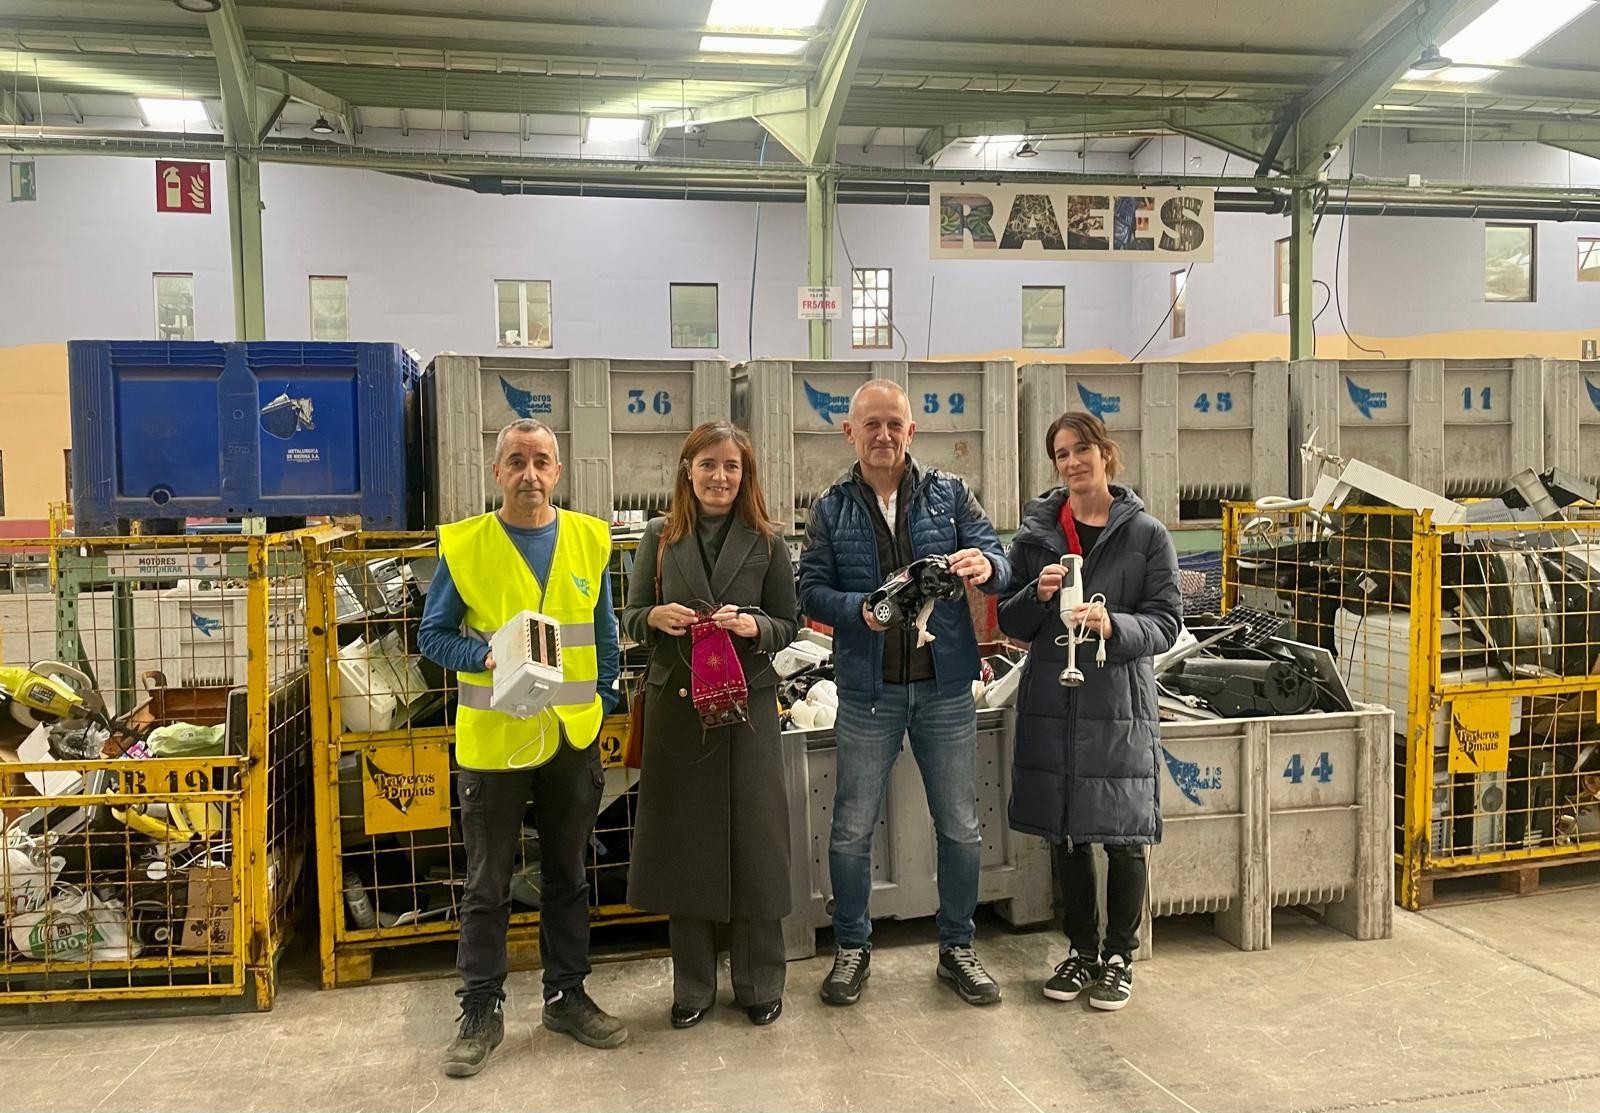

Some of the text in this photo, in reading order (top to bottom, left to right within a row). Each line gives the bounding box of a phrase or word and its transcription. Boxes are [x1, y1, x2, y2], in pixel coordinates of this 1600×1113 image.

[939, 194, 1205, 252] RAEES
[627, 389, 672, 415] 36
[923, 392, 965, 414] 52
[1193, 391, 1233, 413] 45
[1461, 386, 1492, 410] 11
[138, 557, 177, 566] MOTORES
[1282, 751, 1334, 784] 44
[164, 769, 210, 793] 19
